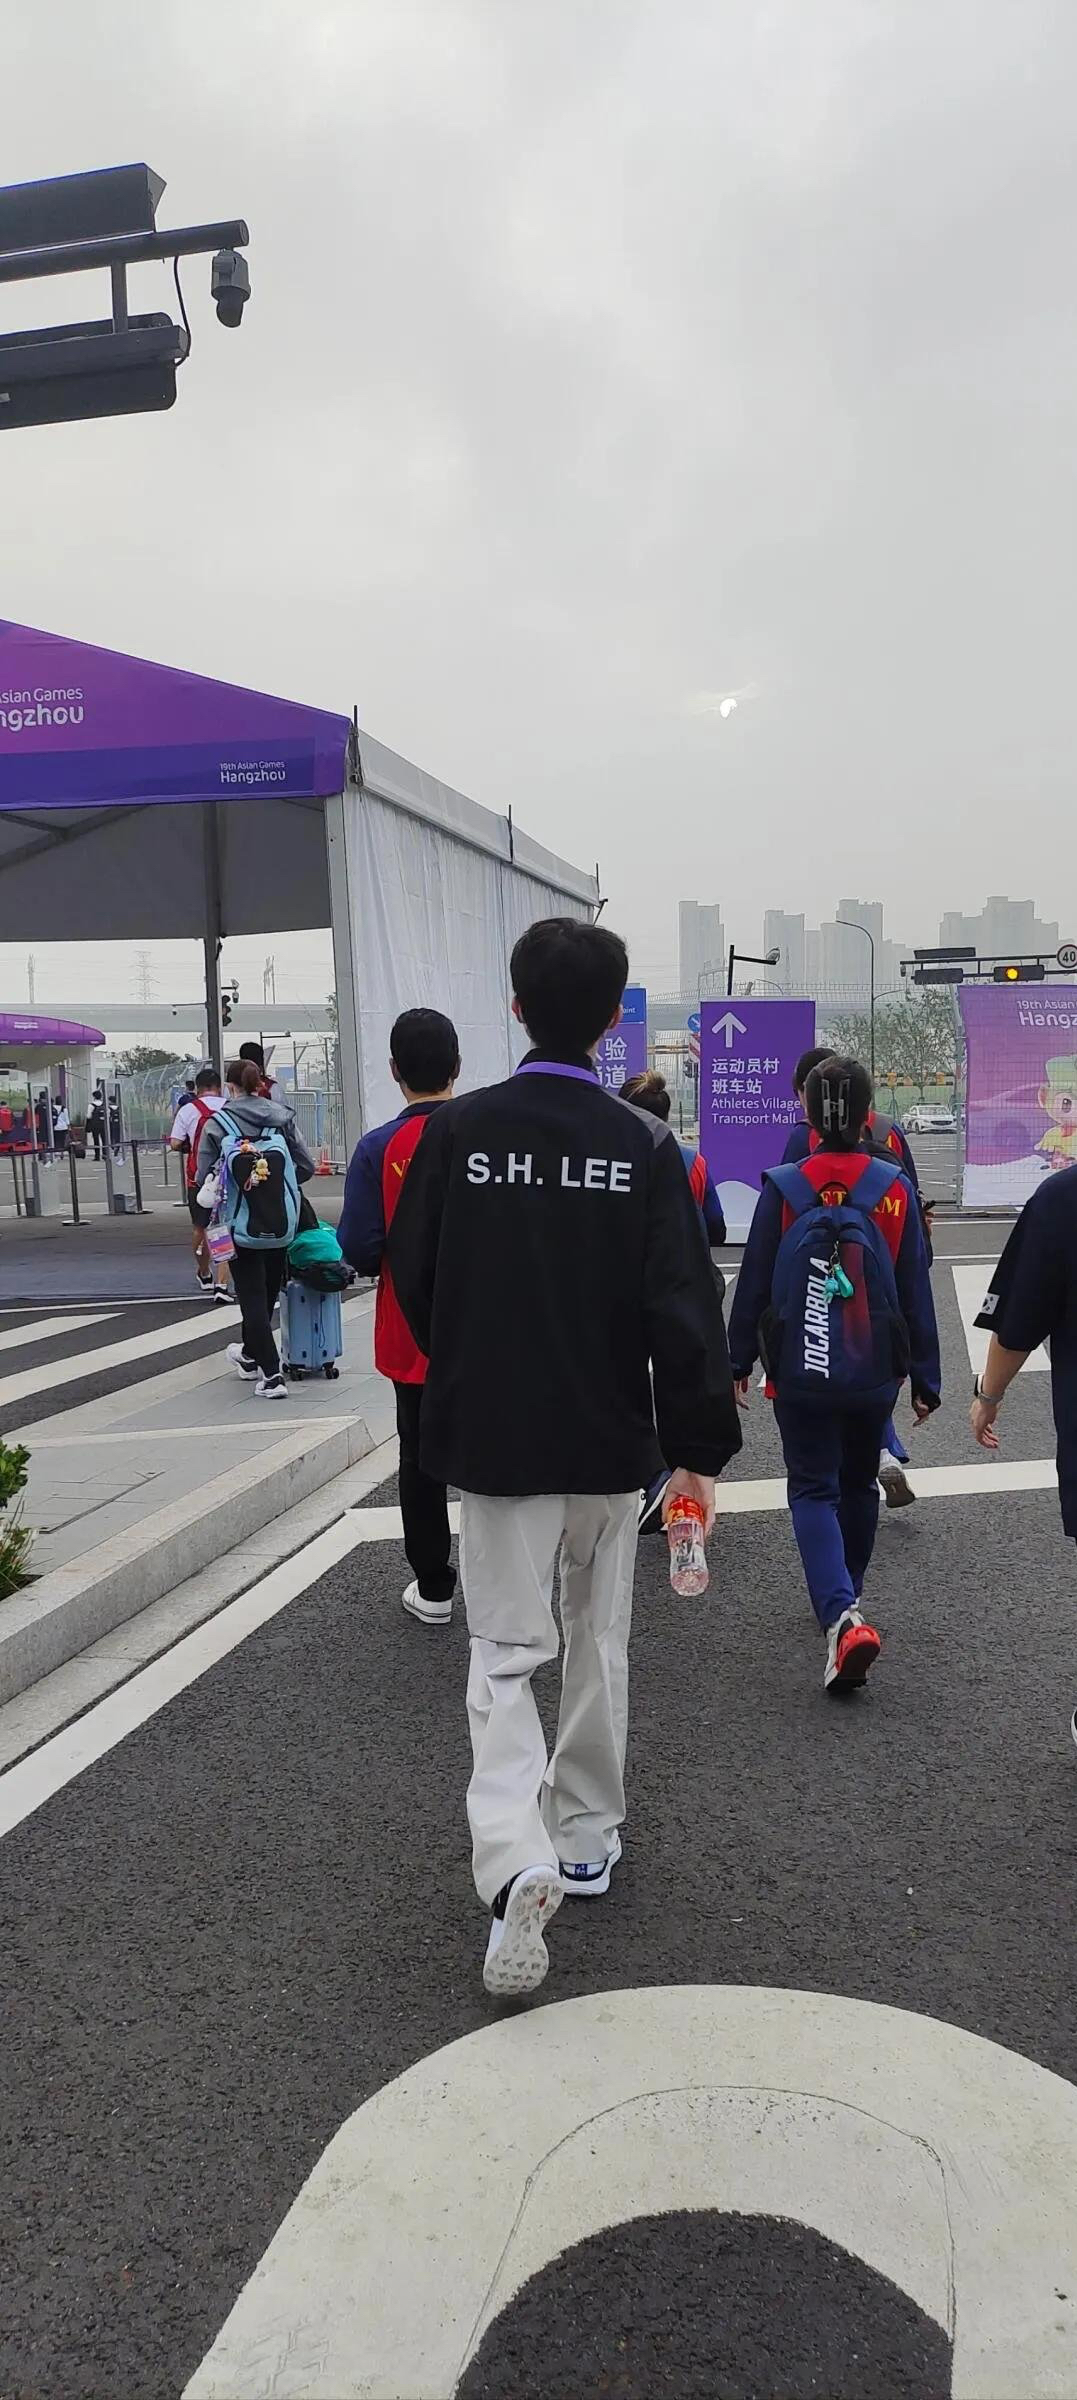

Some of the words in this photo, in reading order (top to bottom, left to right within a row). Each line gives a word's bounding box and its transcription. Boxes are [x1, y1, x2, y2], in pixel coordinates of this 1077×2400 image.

[33, 687, 83, 702] Games
[220, 763, 236, 771] 19th
[238, 762, 258, 770] Asian
[259, 761, 285, 769] Games
[220, 769, 286, 784] Hangzhou
[1062, 951, 1076, 962] 40
[1017, 1000, 1042, 1010] 19th
[1044, 1000, 1075, 1009] Asian
[595, 1036, 628, 1061] 验
[712, 1058, 780, 1074] 运动员村
[712, 1079, 762, 1094] 班车站
[711, 1098, 759, 1109] Athletes
[761, 1098, 800, 1112] Village
[712, 1113, 770, 1126] Transport
[773, 1113, 796, 1124] Mall
[466, 1152, 544, 1185] S.H.
[560, 1156, 633, 1193] LEE
